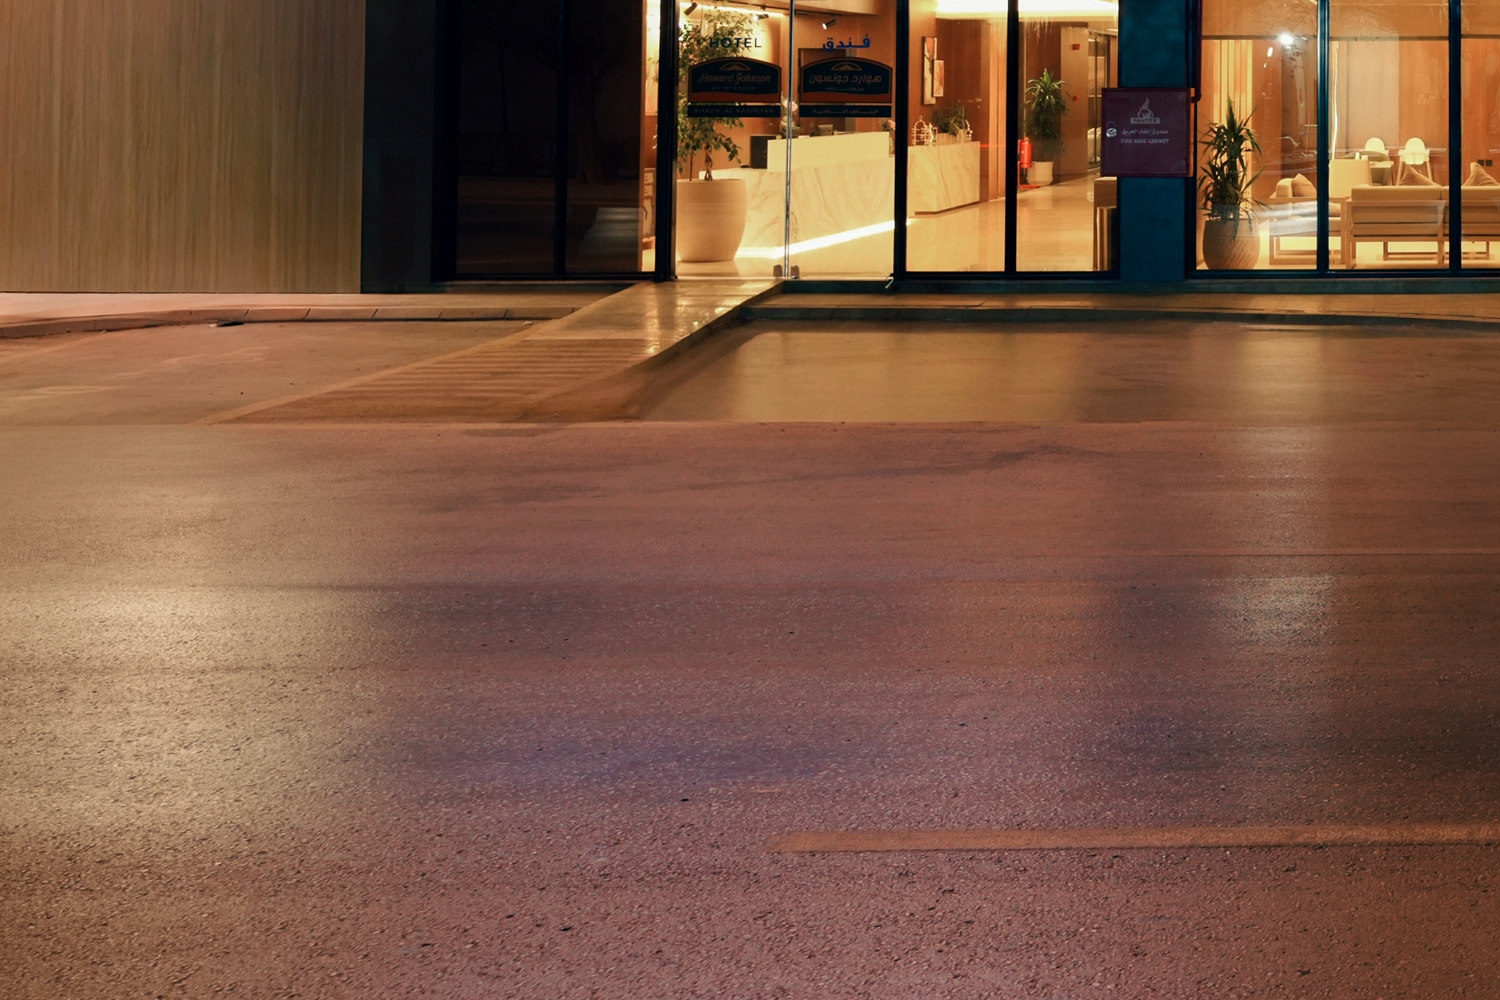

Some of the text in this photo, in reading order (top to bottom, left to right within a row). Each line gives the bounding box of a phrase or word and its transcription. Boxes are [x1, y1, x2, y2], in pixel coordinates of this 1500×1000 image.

[709, 37, 762, 48] HOTEL
[822, 34, 871, 52] فندق
[697, 71, 772, 85] Howard Johnson
[808, 72, 883, 85] هوارد جونسون
